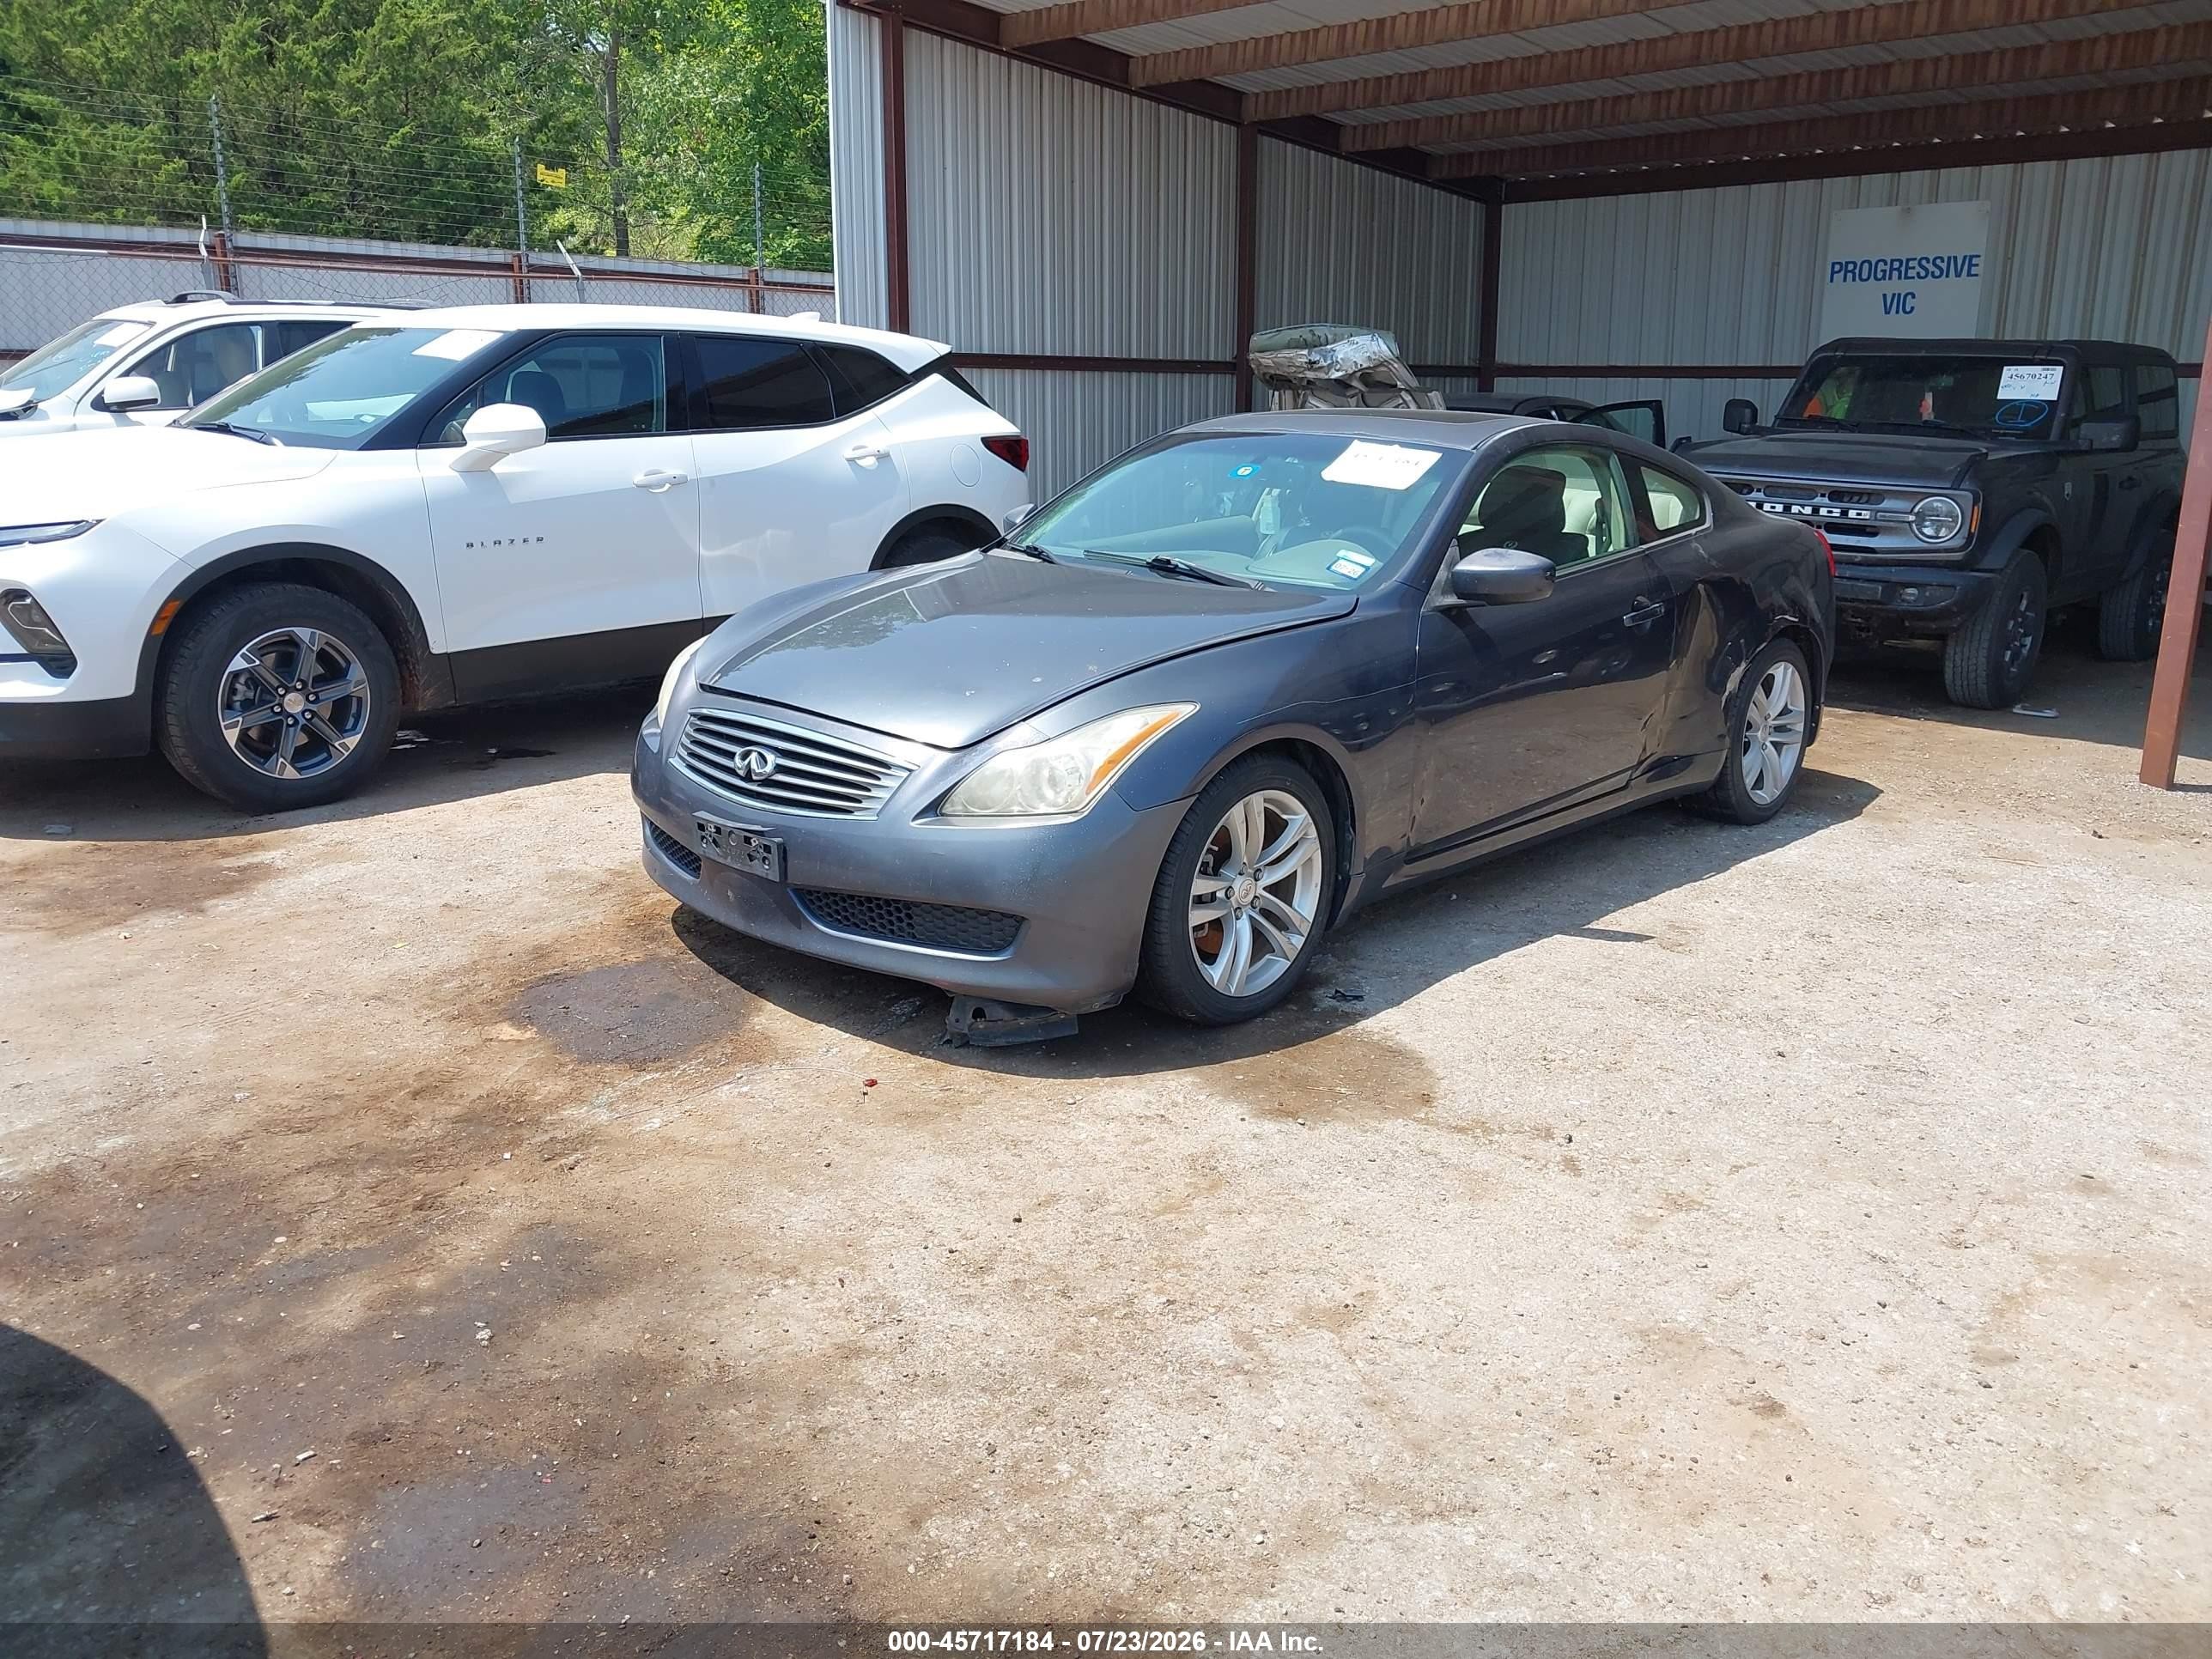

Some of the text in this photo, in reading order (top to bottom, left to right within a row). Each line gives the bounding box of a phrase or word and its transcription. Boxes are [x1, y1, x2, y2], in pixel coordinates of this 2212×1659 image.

[1829, 254, 1981, 283] PROGRESSIVE
[1881, 291, 1917, 315] VIC
[465, 537, 544, 549] BLAZER
